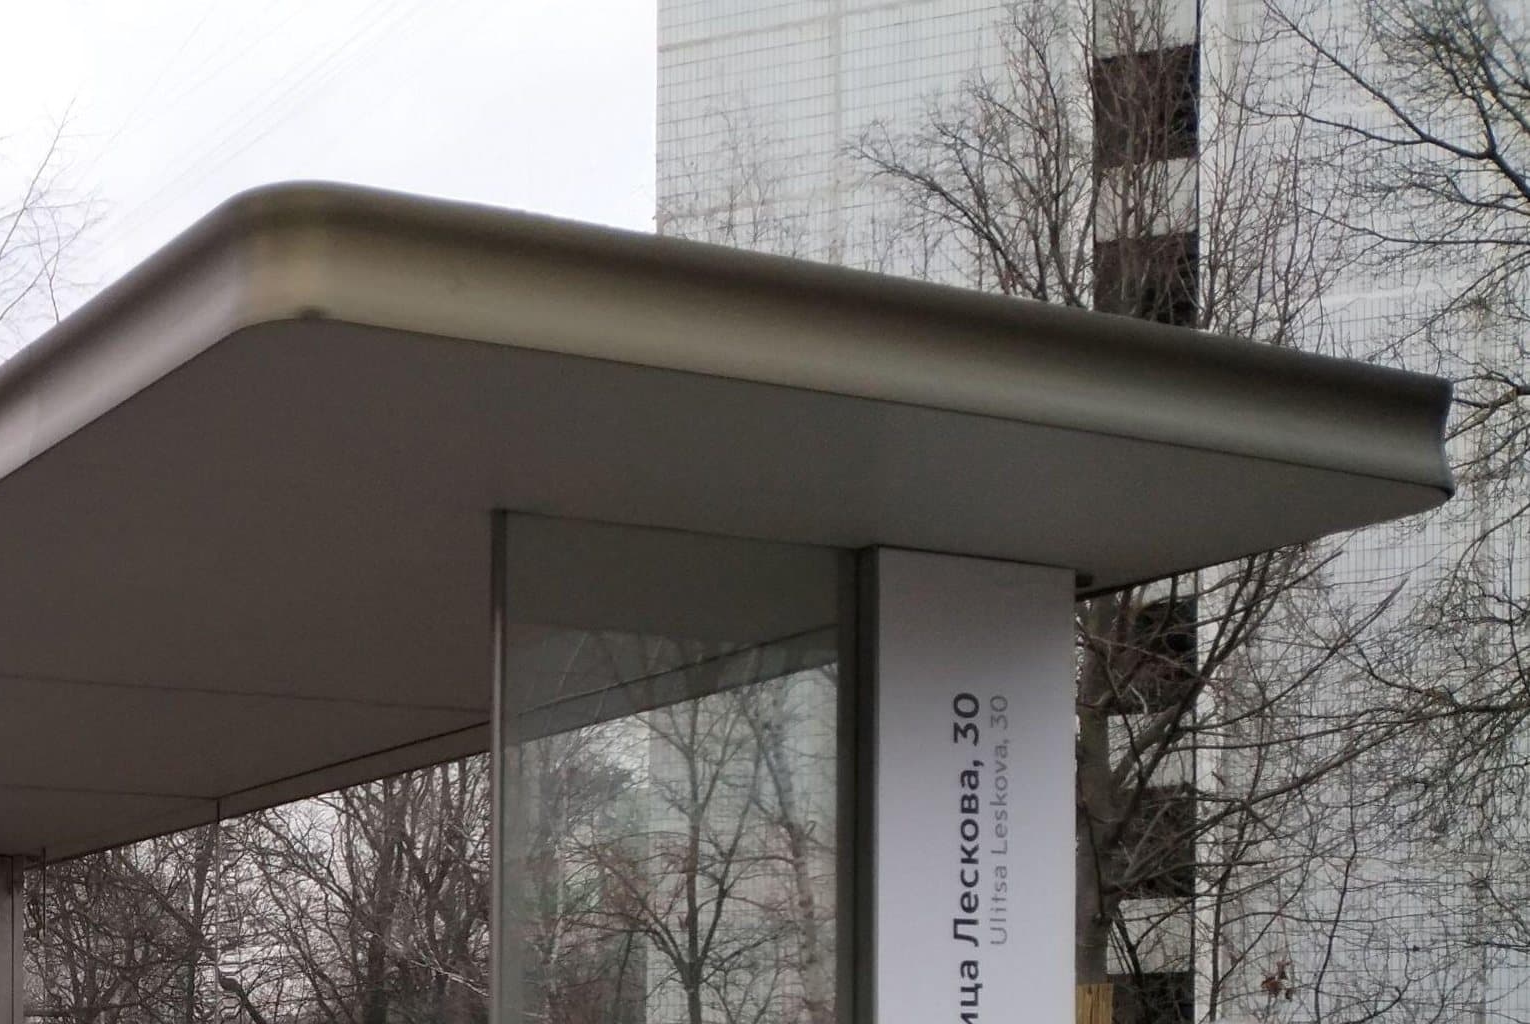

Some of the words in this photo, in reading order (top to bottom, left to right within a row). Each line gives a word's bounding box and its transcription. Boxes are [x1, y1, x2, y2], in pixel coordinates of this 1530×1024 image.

[953, 692, 980, 746] 30
[990, 695, 1008, 729] 30
[990, 739, 1010, 855] Leskova,
[953, 759, 984, 947] Лескова,
[990, 864, 1008, 945] Ulitsa
